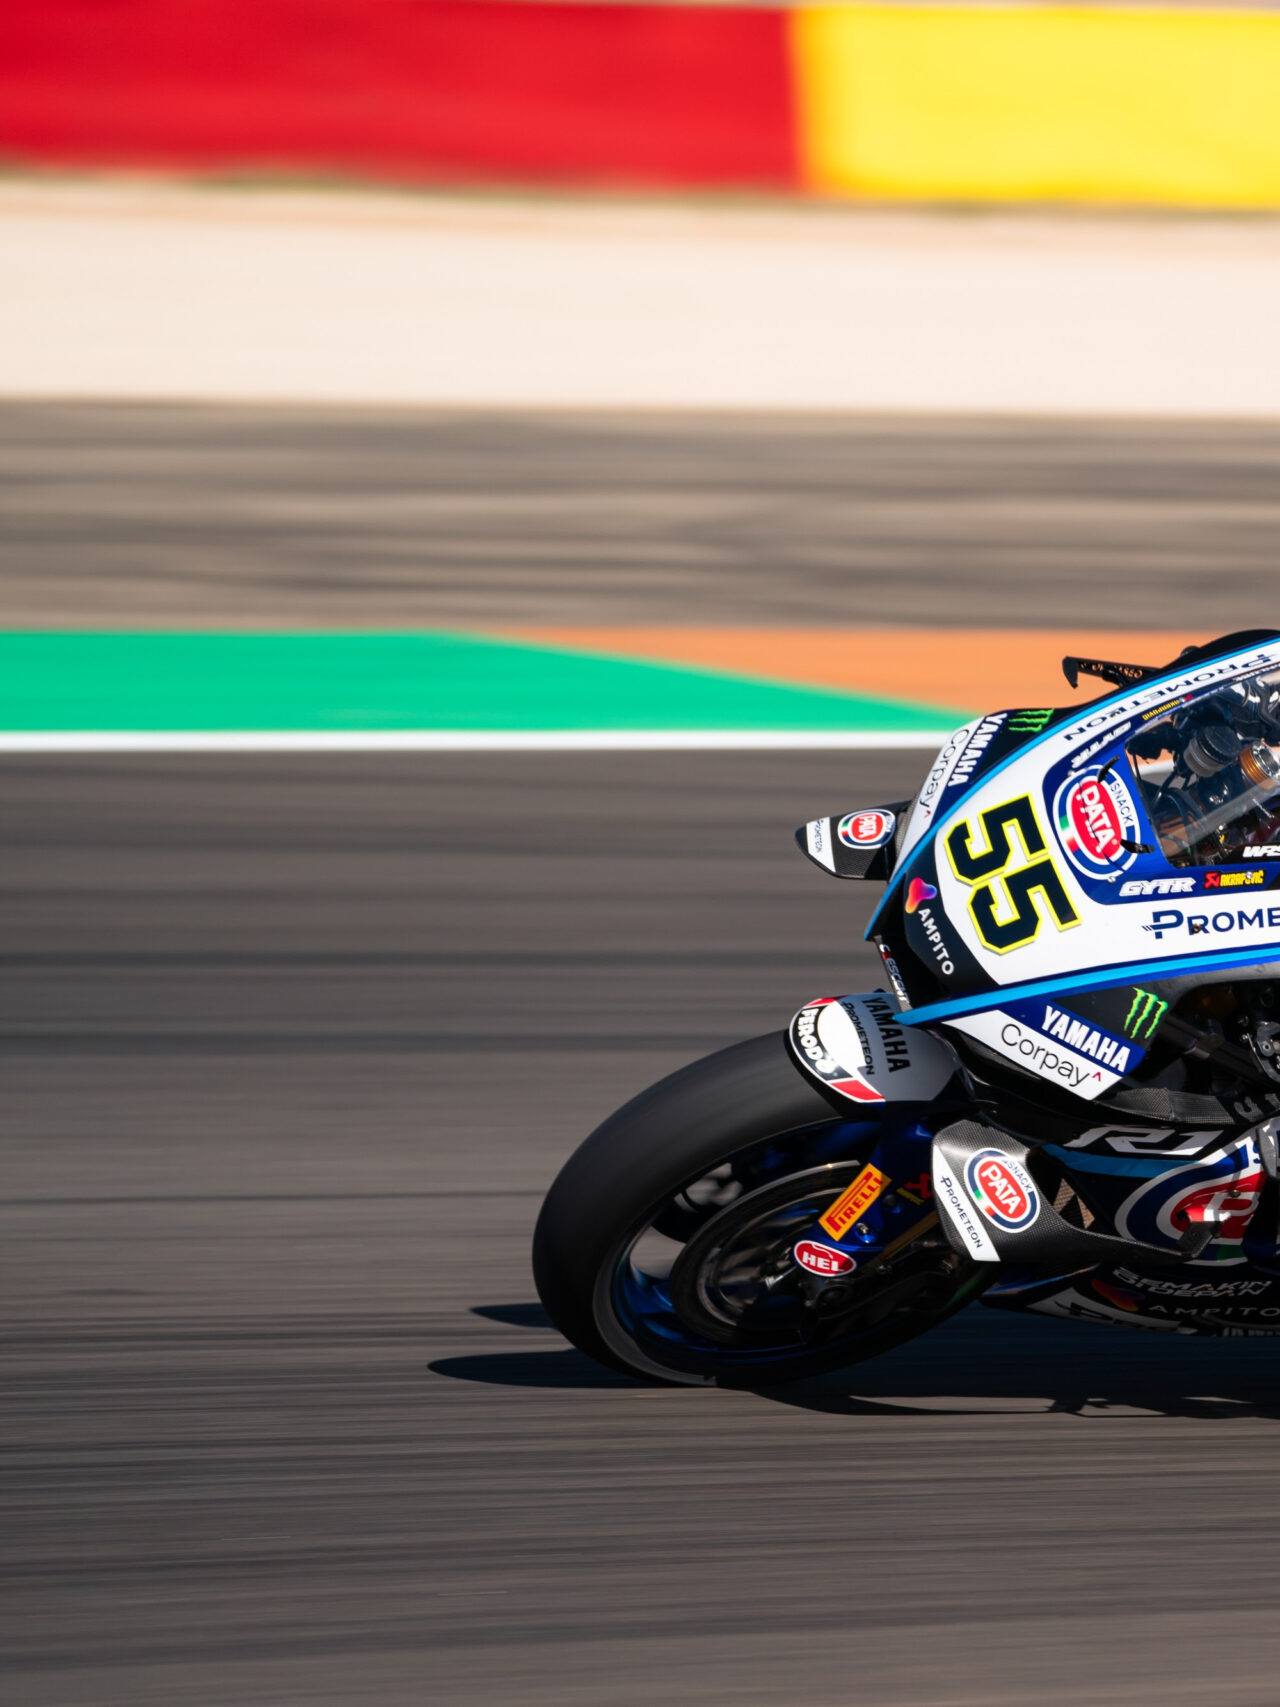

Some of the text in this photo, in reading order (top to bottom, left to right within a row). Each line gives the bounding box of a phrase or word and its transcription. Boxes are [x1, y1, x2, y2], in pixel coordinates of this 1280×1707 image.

[919, 728, 970, 808] Corpay
[947, 712, 1007, 787] YAMAHA
[858, 815, 877, 839] PATA
[1075, 782, 1111, 853] PATA
[1110, 782, 1134, 830] SNACK
[944, 792, 1083, 955] 55
[1119, 877, 1196, 897] GYTR
[917, 907, 954, 975] AMPITO
[842, 1001, 875, 1075] PROMETEON
[862, 997, 911, 1073] YAMAHA
[1001, 1023, 1090, 1087] Corpay
[1041, 1005, 1131, 1073] YAMAHA
[826, 1171, 884, 1233] PIRELLI
[981, 1164, 1022, 1215] PATA
[1006, 1160, 1033, 1193] SNACK
[940, 1175, 983, 1249] PROMETEON
[802, 1250, 845, 1272] HEL
